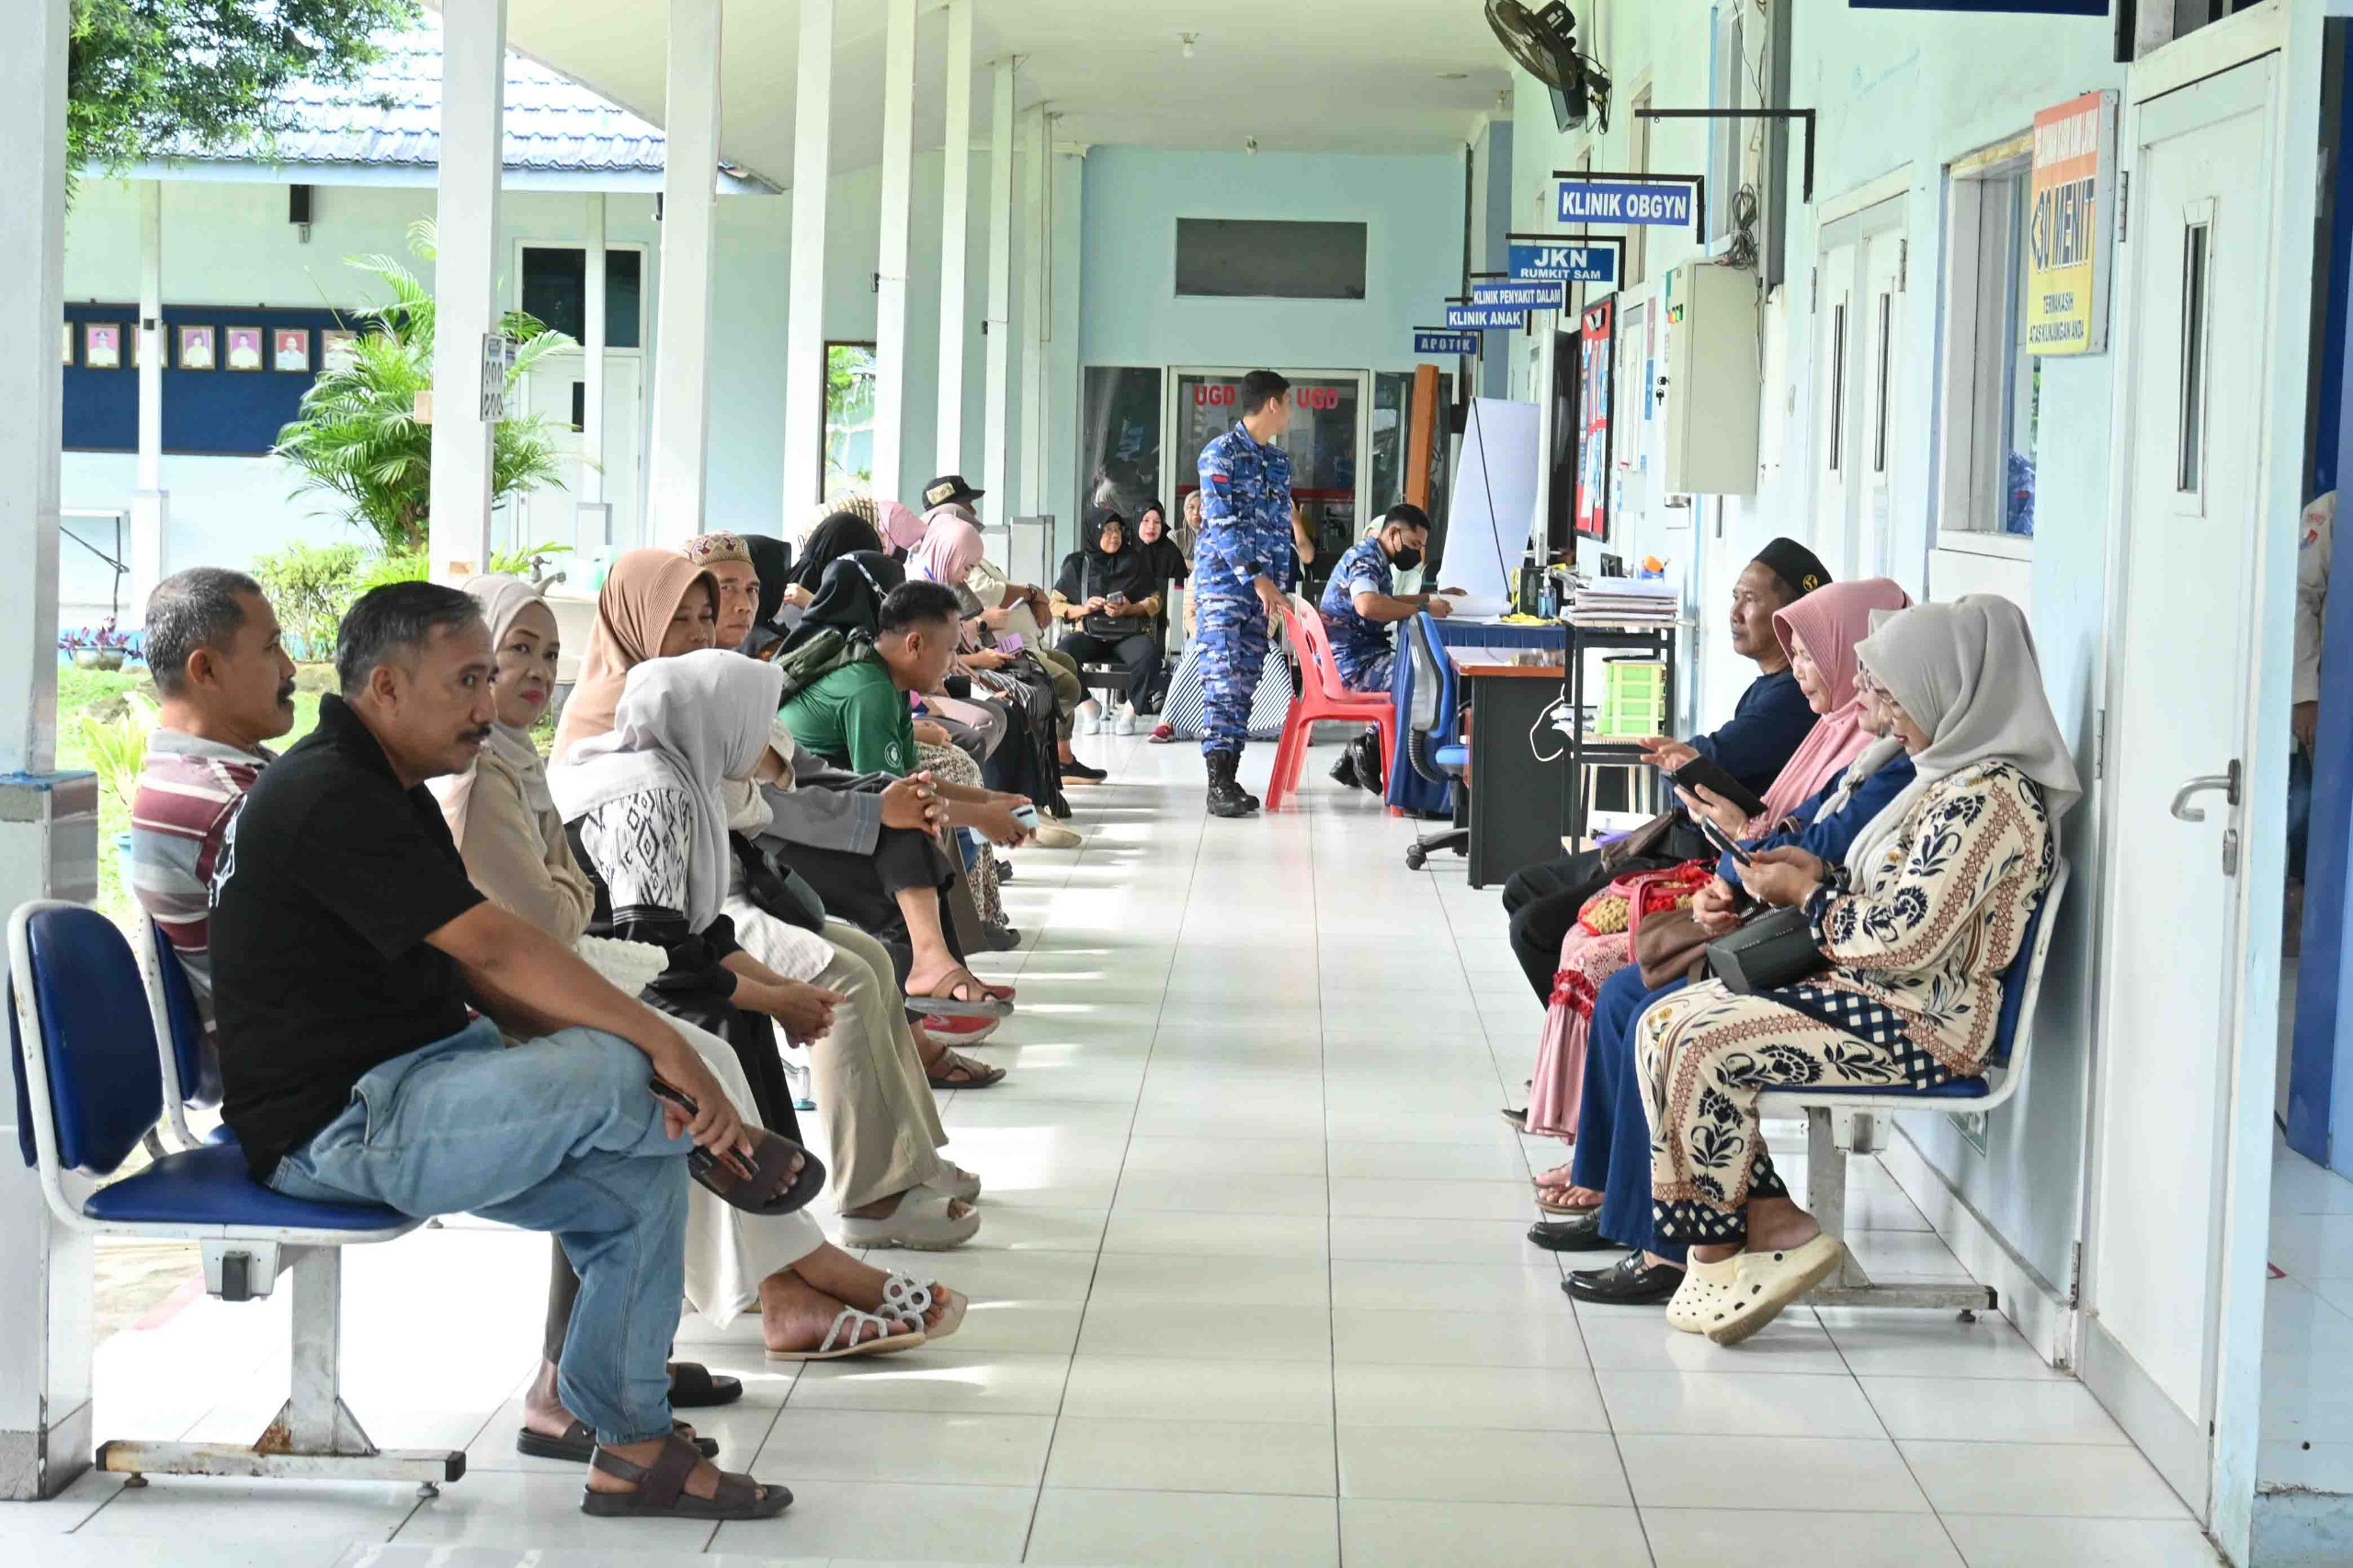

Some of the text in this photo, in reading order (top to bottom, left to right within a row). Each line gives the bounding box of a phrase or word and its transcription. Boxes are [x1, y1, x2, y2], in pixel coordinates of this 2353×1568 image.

[1563, 191, 1687, 219] KLINIK OBGYN
[2052, 176, 2096, 268] MENIT
[1534, 249, 1587, 268] JKN
[1520, 268, 1601, 279] RUMKIT SAM
[1474, 289, 1561, 305] KLINIK PENYAKIT DALAM
[1449, 311, 1521, 325] KLINIK ANAK
[1420, 337, 1471, 351] APOTIK
[1195, 384, 1236, 406] UGD
[1296, 387, 1338, 410] UGD
